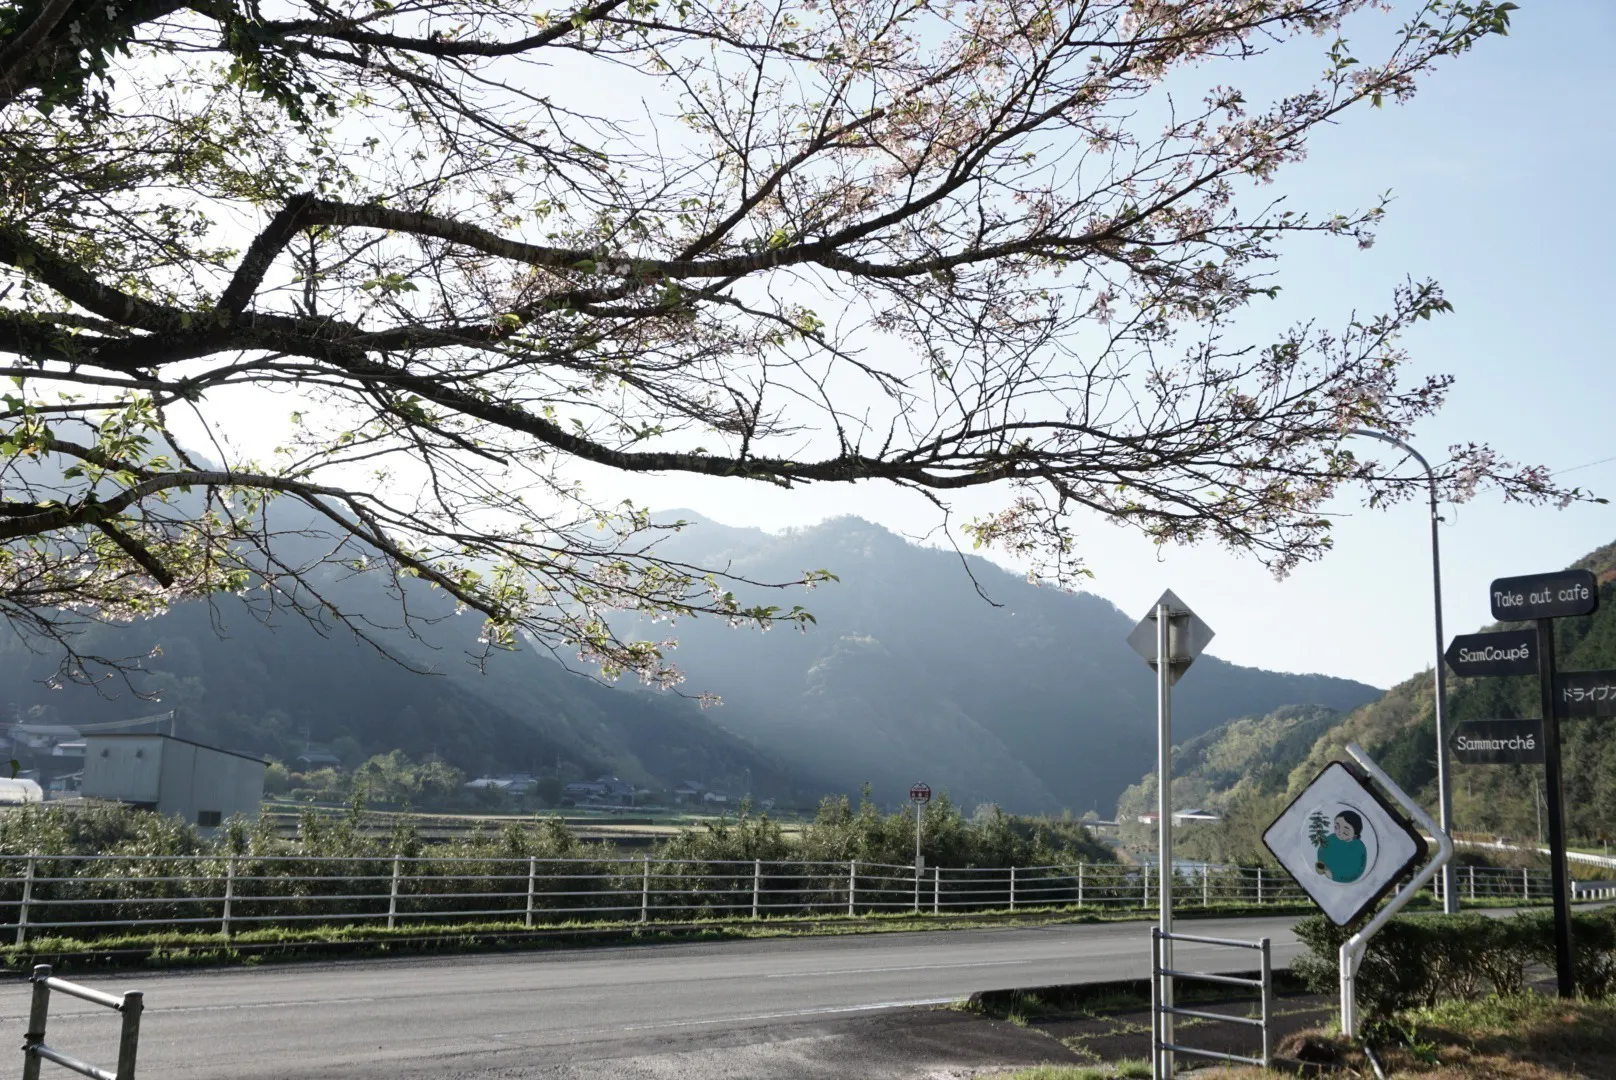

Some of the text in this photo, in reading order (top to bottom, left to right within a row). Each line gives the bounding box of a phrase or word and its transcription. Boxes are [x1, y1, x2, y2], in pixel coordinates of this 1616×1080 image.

[1494, 583, 1589, 608] Take out cafe
[1459, 643, 1530, 663] SamCoupé
[1457, 733, 1536, 751] Sammarché
